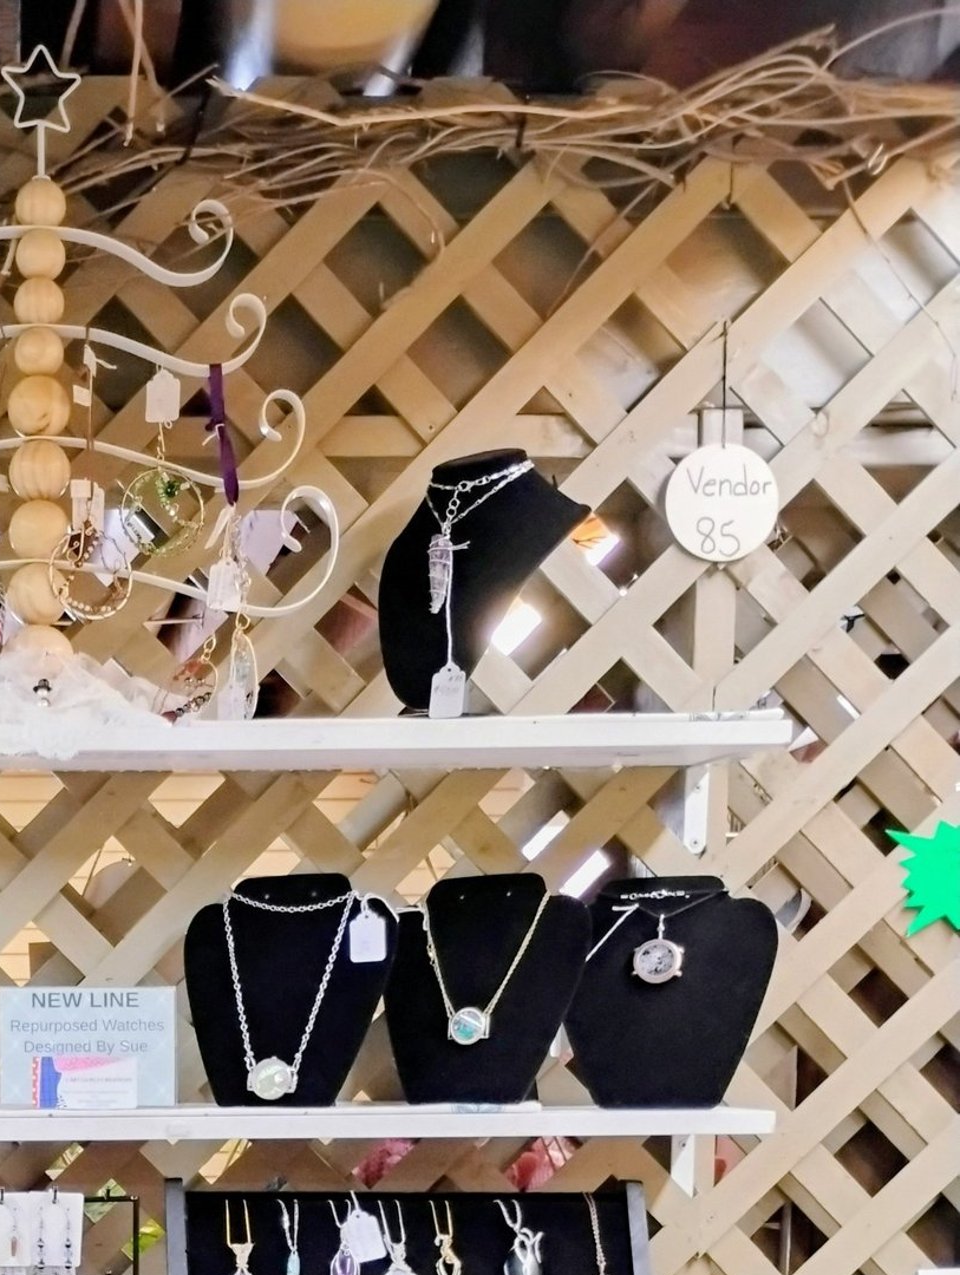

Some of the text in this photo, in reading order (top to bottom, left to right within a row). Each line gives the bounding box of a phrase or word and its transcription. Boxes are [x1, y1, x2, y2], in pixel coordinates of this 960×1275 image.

[685, 463, 773, 497] Vendor
[696, 515, 741, 558] 85
[31, 991, 140, 1009] NEW LINE
[10, 1018, 165, 1035] Repurposed Watches
[24, 1039, 148, 1055] Designed By Sue
